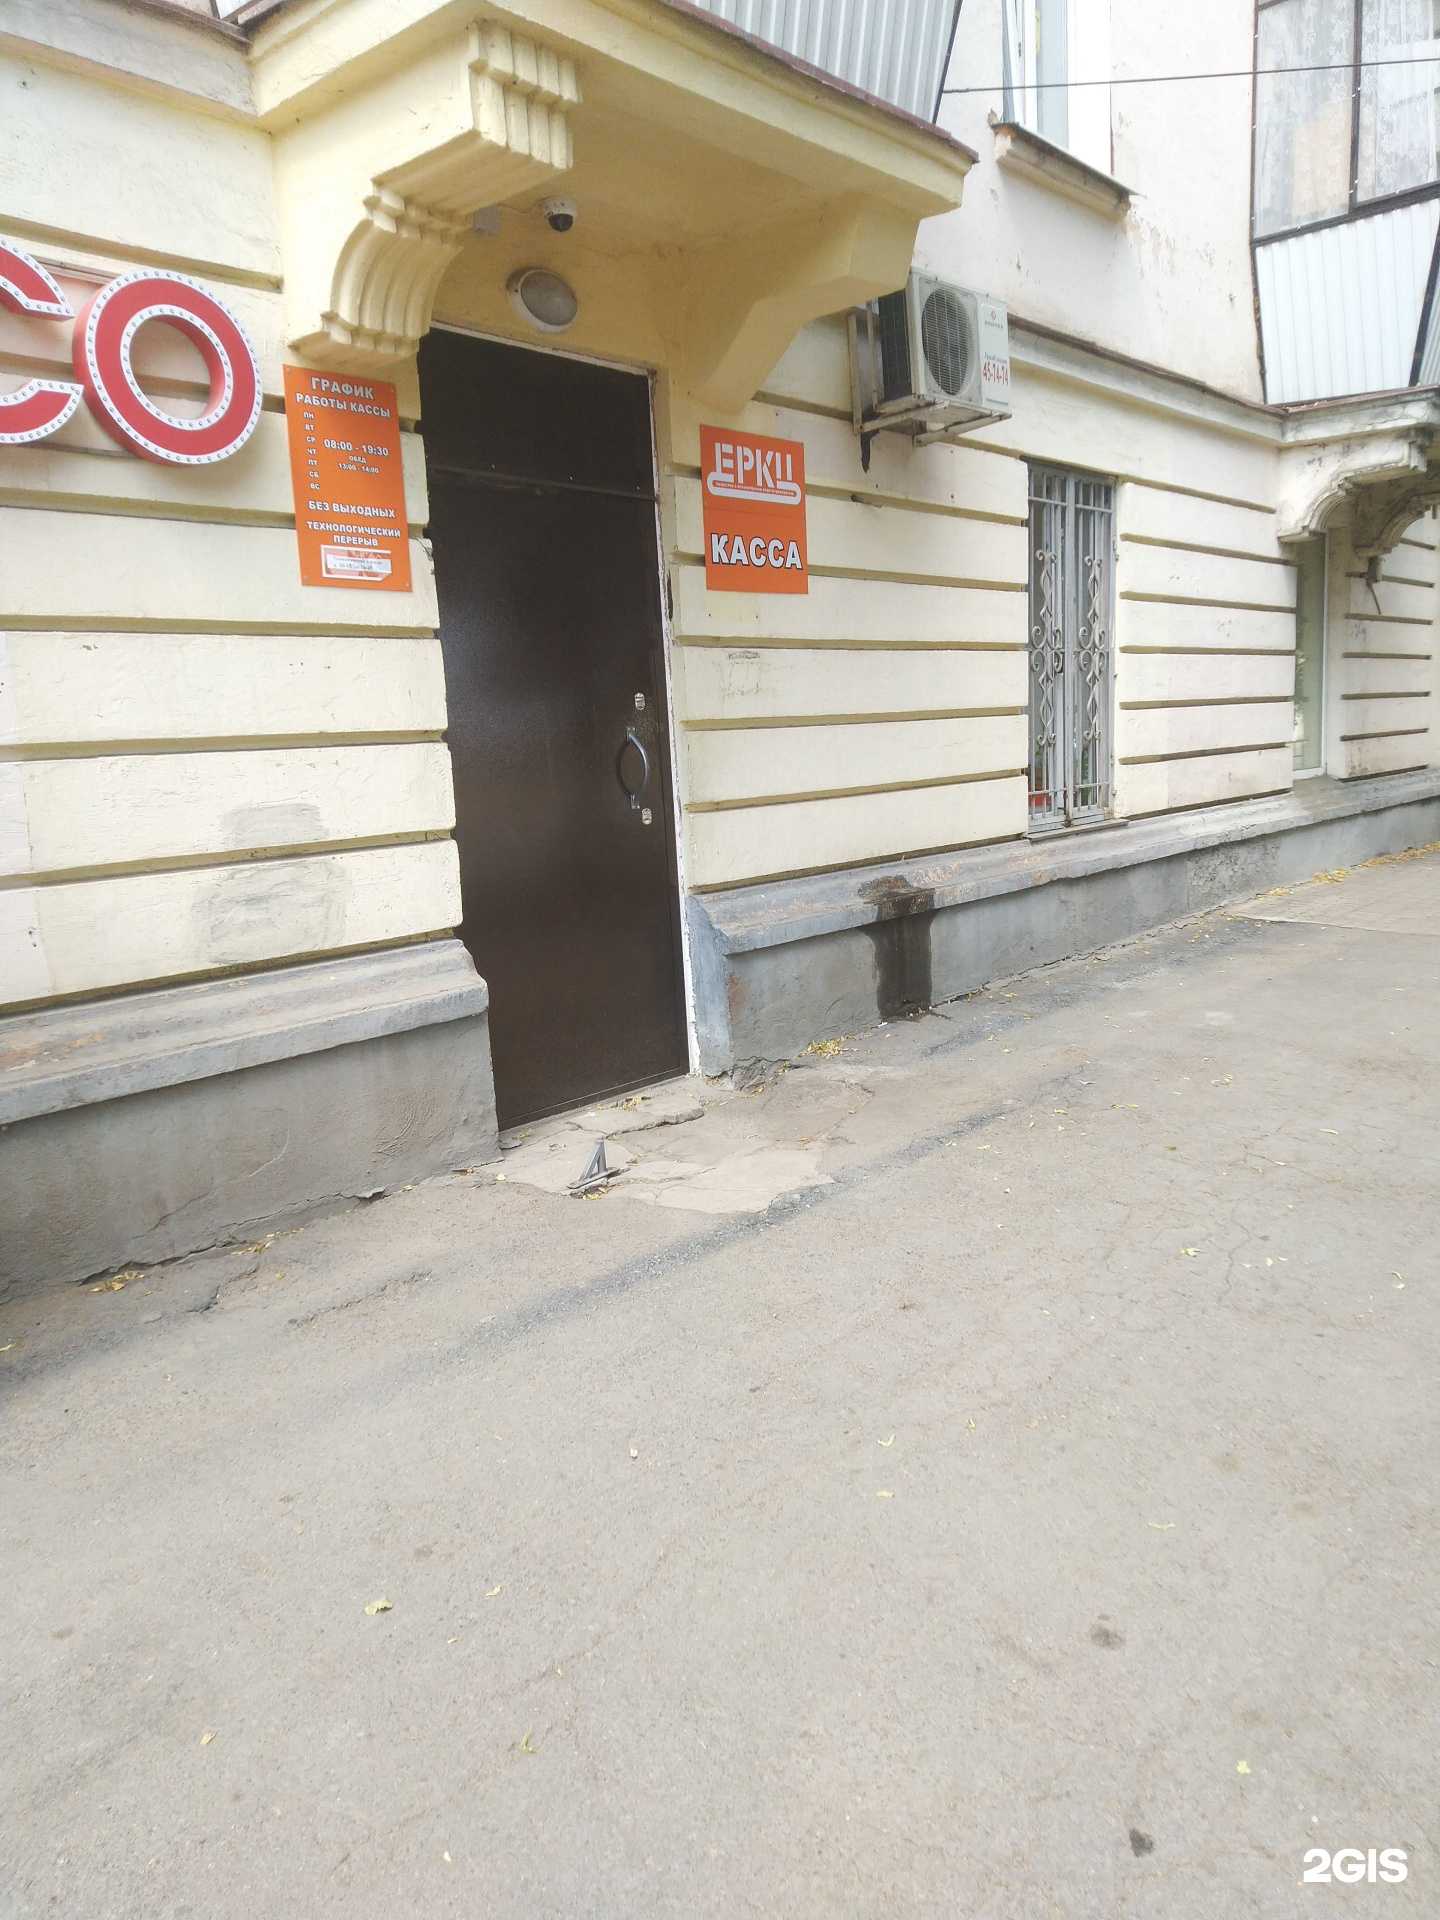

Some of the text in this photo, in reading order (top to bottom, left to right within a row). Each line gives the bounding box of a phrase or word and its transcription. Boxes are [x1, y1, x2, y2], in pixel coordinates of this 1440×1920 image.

[311, 376, 375, 400] ГРАФИК
[296, 392, 391, 417] РАБОТЫ КАССЫ
[303, 411, 314, 419] ПН
[324, 438, 353, 452] 08:00
[362, 444, 389, 457] 19:30
[712, 442, 798, 492] ЕРКЦ
[310, 482, 320, 490] ВС
[308, 500, 396, 518] БЕЗ ВЫХОДНЫХ
[333, 535, 379, 546] ПЕРЕРЫВ
[711, 532, 803, 570] КАССА
